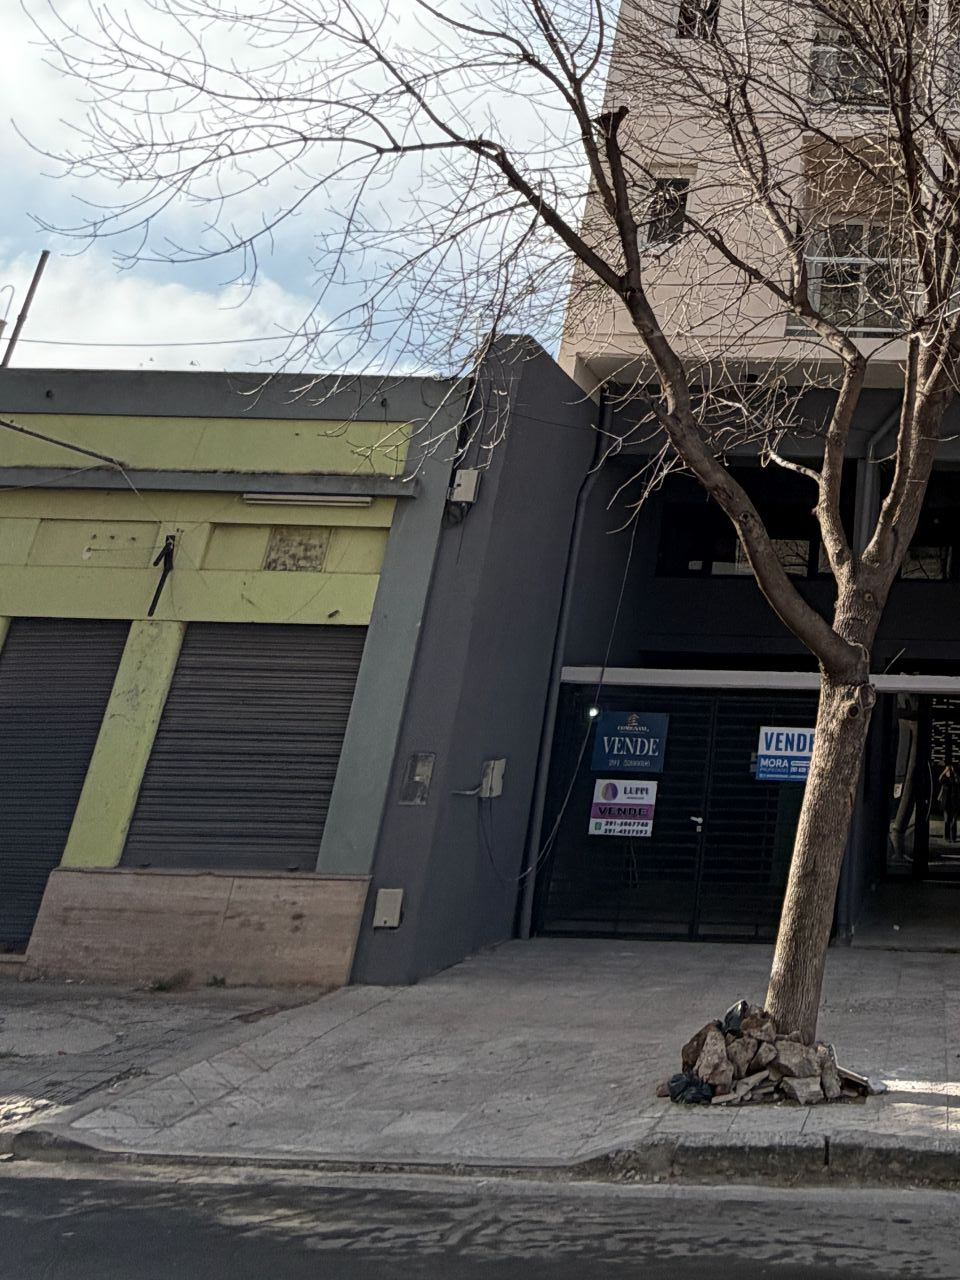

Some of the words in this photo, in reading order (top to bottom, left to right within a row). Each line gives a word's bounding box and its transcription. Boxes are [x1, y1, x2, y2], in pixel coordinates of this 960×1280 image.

[603, 736, 660, 756] VENDE
[760, 758, 789, 768] MORA
[598, 806, 648, 818] VENDE
